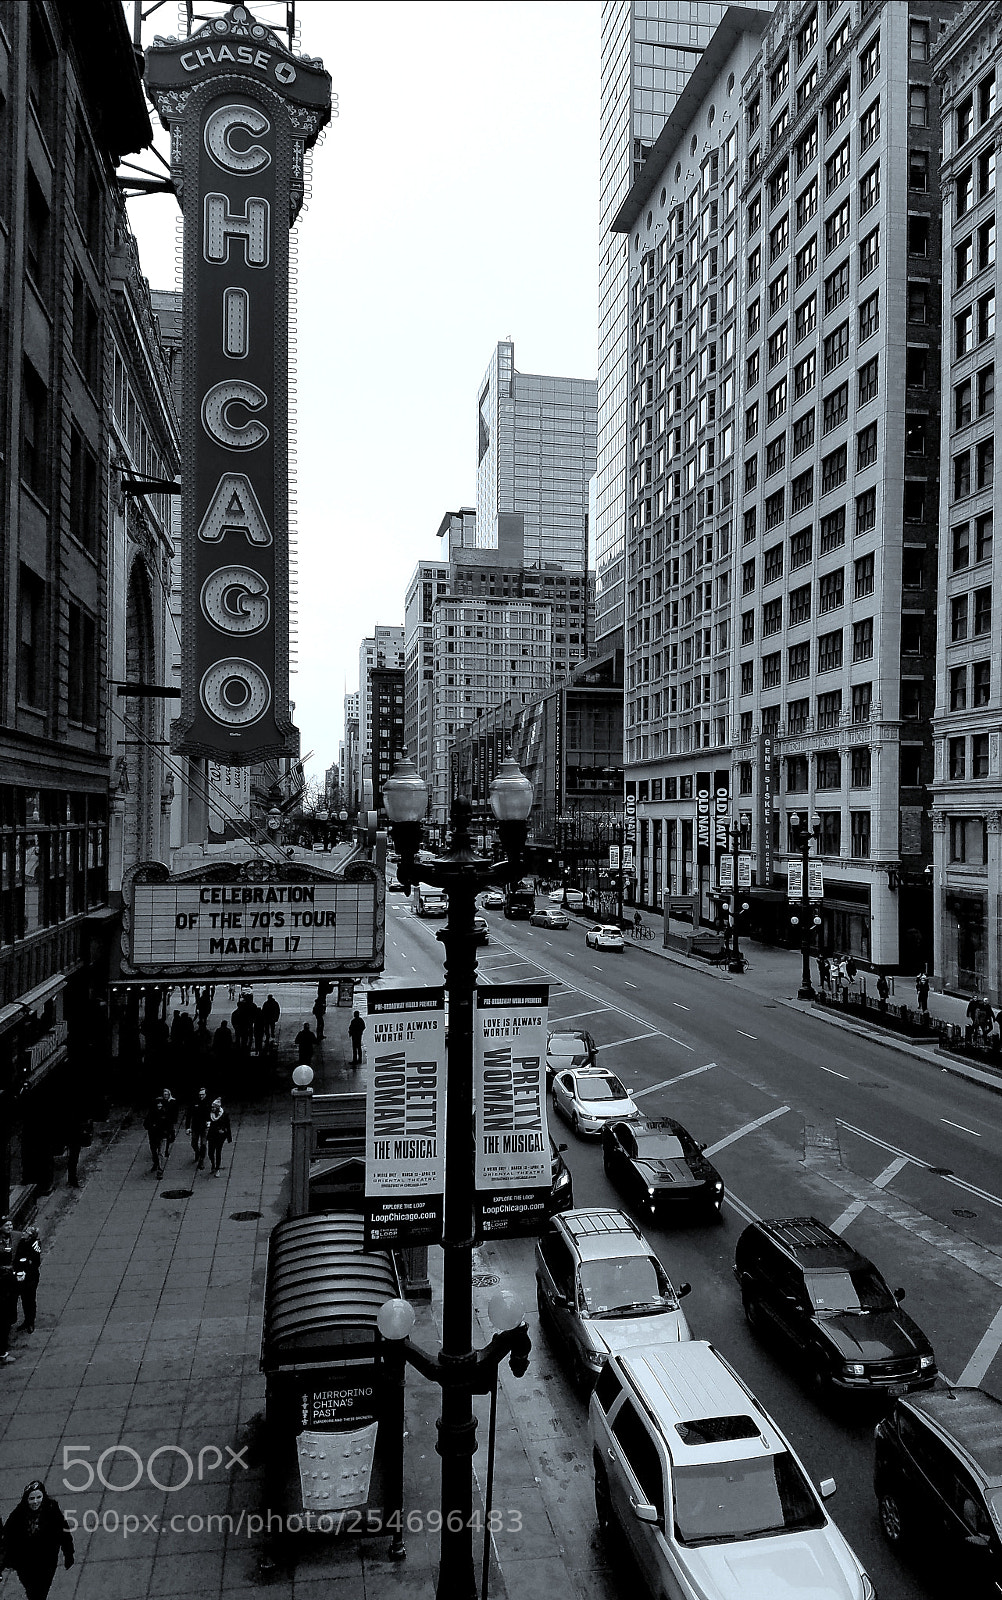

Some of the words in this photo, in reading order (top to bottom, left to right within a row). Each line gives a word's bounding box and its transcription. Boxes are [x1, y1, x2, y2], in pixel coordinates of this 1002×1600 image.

[179, 44, 272, 72] CHASE
[198, 104, 273, 728] CHICAGO
[626, 794, 636, 815] OLD
[698, 789, 709, 813] OLD
[716, 787, 728, 813] OLD
[626, 816, 636, 842] NAVY
[698, 815, 709, 847] NAVY
[715, 815, 727, 849] NAVY
[200, 886, 315, 904] CELEBRATION
[175, 912, 199, 930] OF
[209, 912, 242, 929] THE
[251, 911, 285, 928] 70'S
[290, 911, 336, 927] TOUR
[209, 936, 274, 955] MARCH
[284, 935, 301, 953] 17
[374, 1024, 393, 1034] LOVE
[395, 1022, 404, 1031] IS
[406, 1020, 438, 1031] ALWAYS
[483, 1018, 501, 1028] LOVE
[503, 1018, 511, 1027] IS
[512, 1017, 542, 1027] ALWAYS
[483, 1027, 510, 1038] WORTH
[512, 1027, 521, 1036] IT.
[374, 1032, 403, 1043] WORTH
[406, 1031, 416, 1040] IT.
[374, 1052, 406, 1137] WOMAN
[406, 1061, 437, 1138] PRETTY
[483, 1047, 514, 1132] WOMAN
[512, 1056, 542, 1131] PRETTY
[374, 1141, 391, 1160] THE
[394, 1140, 438, 1160] MUSICAL
[483, 1136, 500, 1155] THE
[503, 1133, 545, 1154] MUSICAL
[482, 1203, 545, 1215] LoopChicago.com
[493, 1195, 513, 1203] EXPLORE
[370, 1212, 437, 1223] LoopChicago.com
[313, 1387, 373, 1400] MIRRORING
[313, 1398, 354, 1409] CHINA'S
[313, 1408, 337, 1418] PAST
